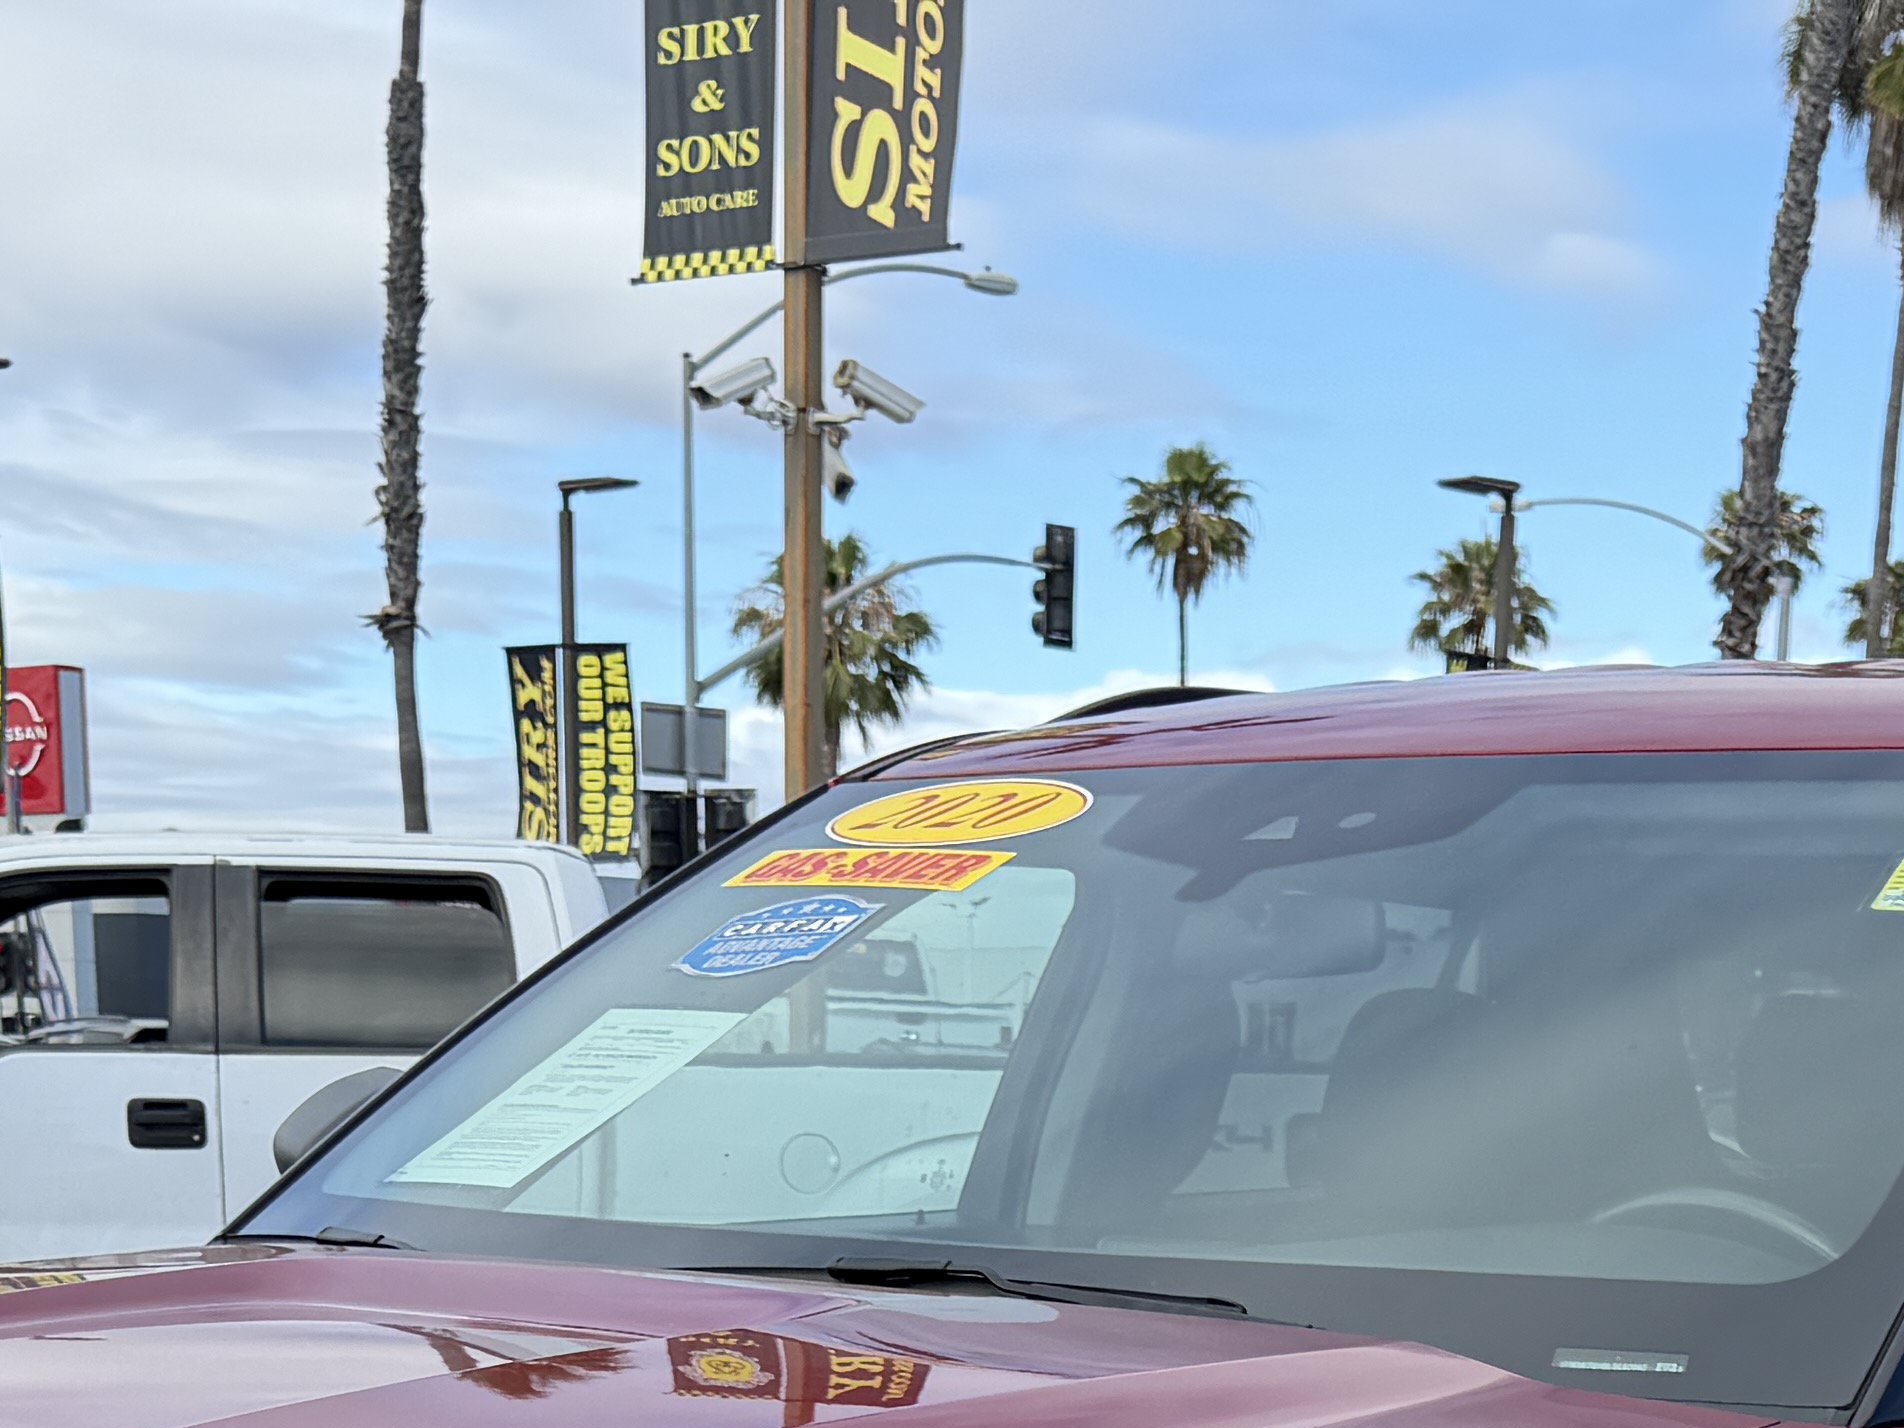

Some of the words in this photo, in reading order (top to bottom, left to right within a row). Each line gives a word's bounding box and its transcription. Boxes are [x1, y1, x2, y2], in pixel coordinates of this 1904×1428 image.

[656, 13, 761, 66] SIRY
[690, 79, 726, 114] &
[831, 0, 908, 230] SI
[905, 0, 945, 222] MOTO
[655, 127, 761, 178] SONS
[658, 194, 706, 218] AUTO
[708, 188, 760, 211] CARE
[577, 655, 604, 722] OUR
[602, 652, 628, 704] WE
[578, 727, 606, 855] TROOPS
[606, 710, 634, 856] SUPPORT
[851, 791, 1062, 830] 2020
[703, 935, 820, 955] ADVANTAGE
[723, 914, 854, 938] CARFAX
[702, 952, 780, 968] DEALER
